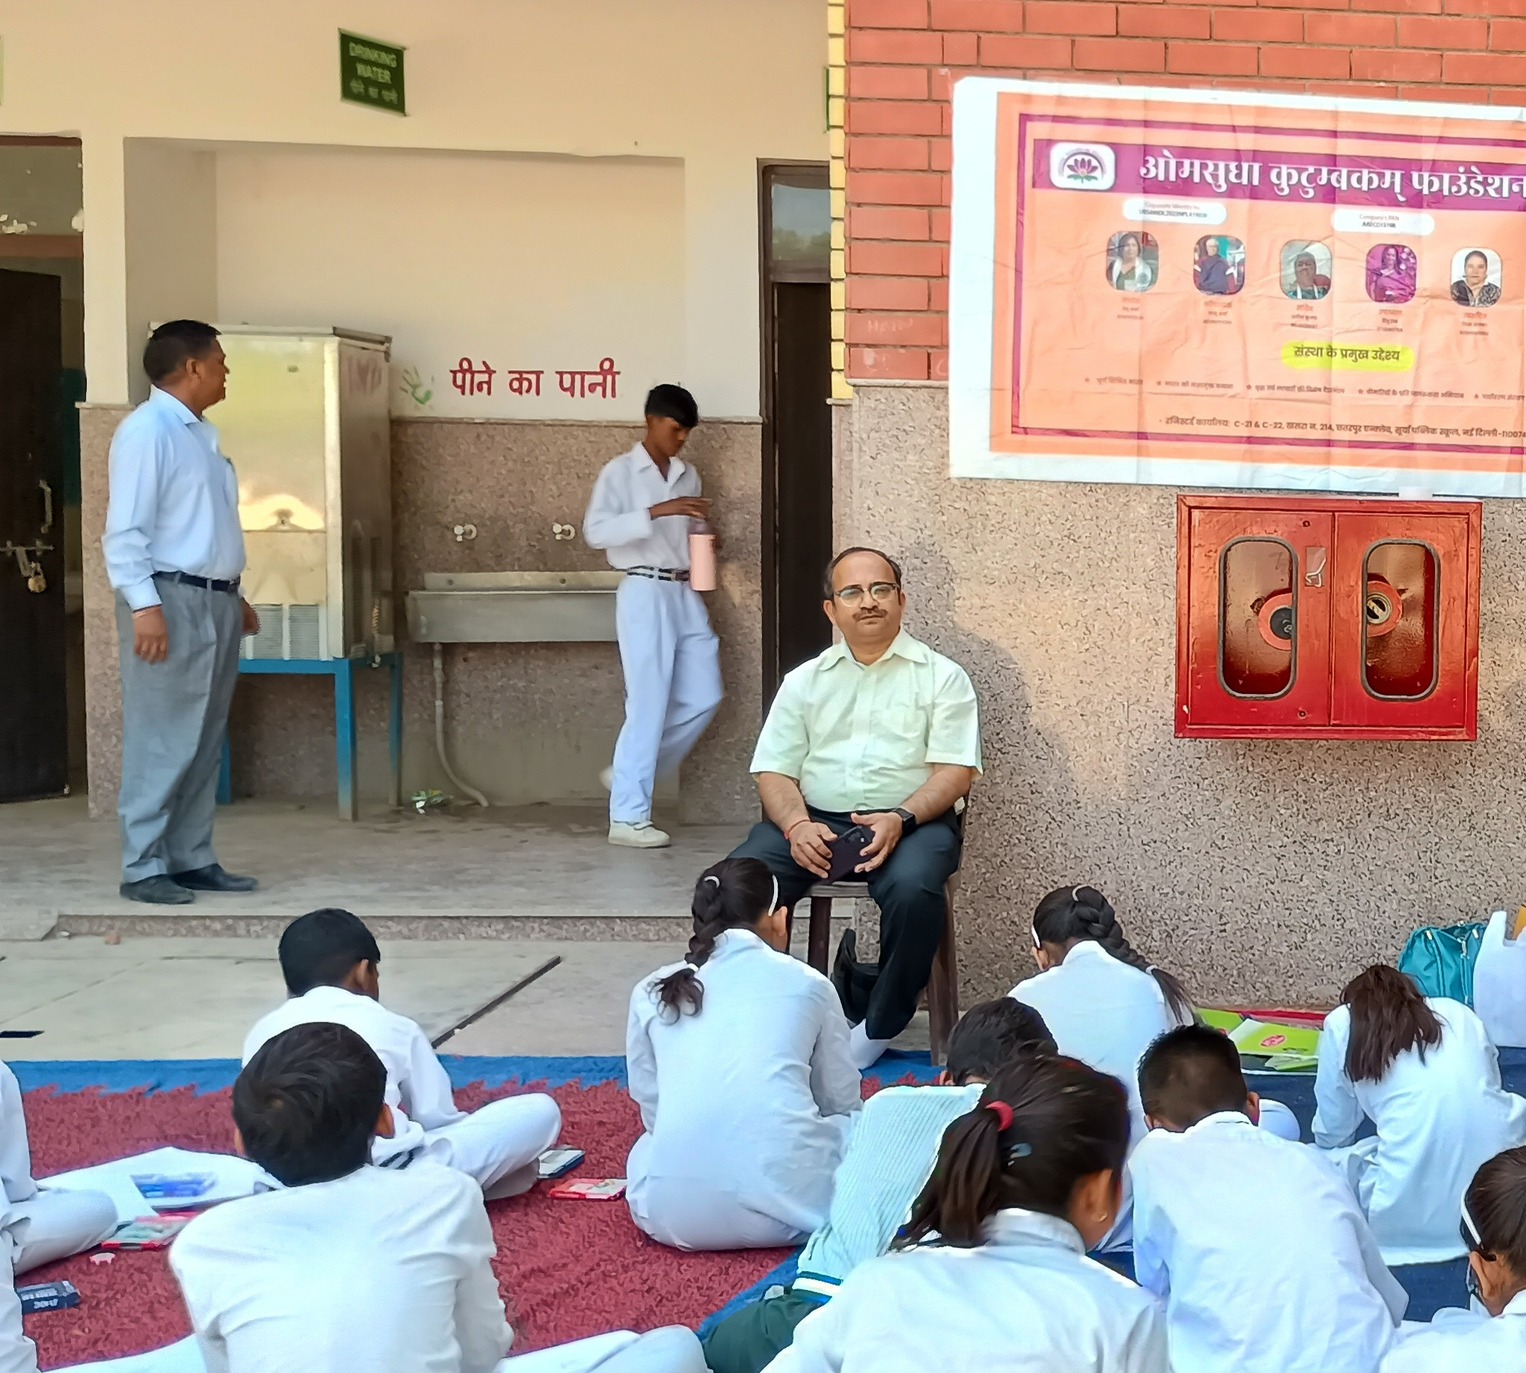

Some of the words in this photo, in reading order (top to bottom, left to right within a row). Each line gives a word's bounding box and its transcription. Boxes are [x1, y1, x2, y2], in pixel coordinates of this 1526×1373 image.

[349, 41, 398, 68] DRINKING
[355, 61, 392, 85] WATER
[1139, 149, 1263, 193] ओमसुधा
[1268, 162, 1407, 202] कुटुम्बकम्
[1293, 344, 1324, 358] संस्था
[1326, 344, 1339, 359] के
[1340, 348, 1369, 363] प्रमुख
[449, 357, 497, 397] पीने
[507, 370, 545, 397] का
[555, 357, 621, 399] पानी
[1254, 420, 1261, 428] &
